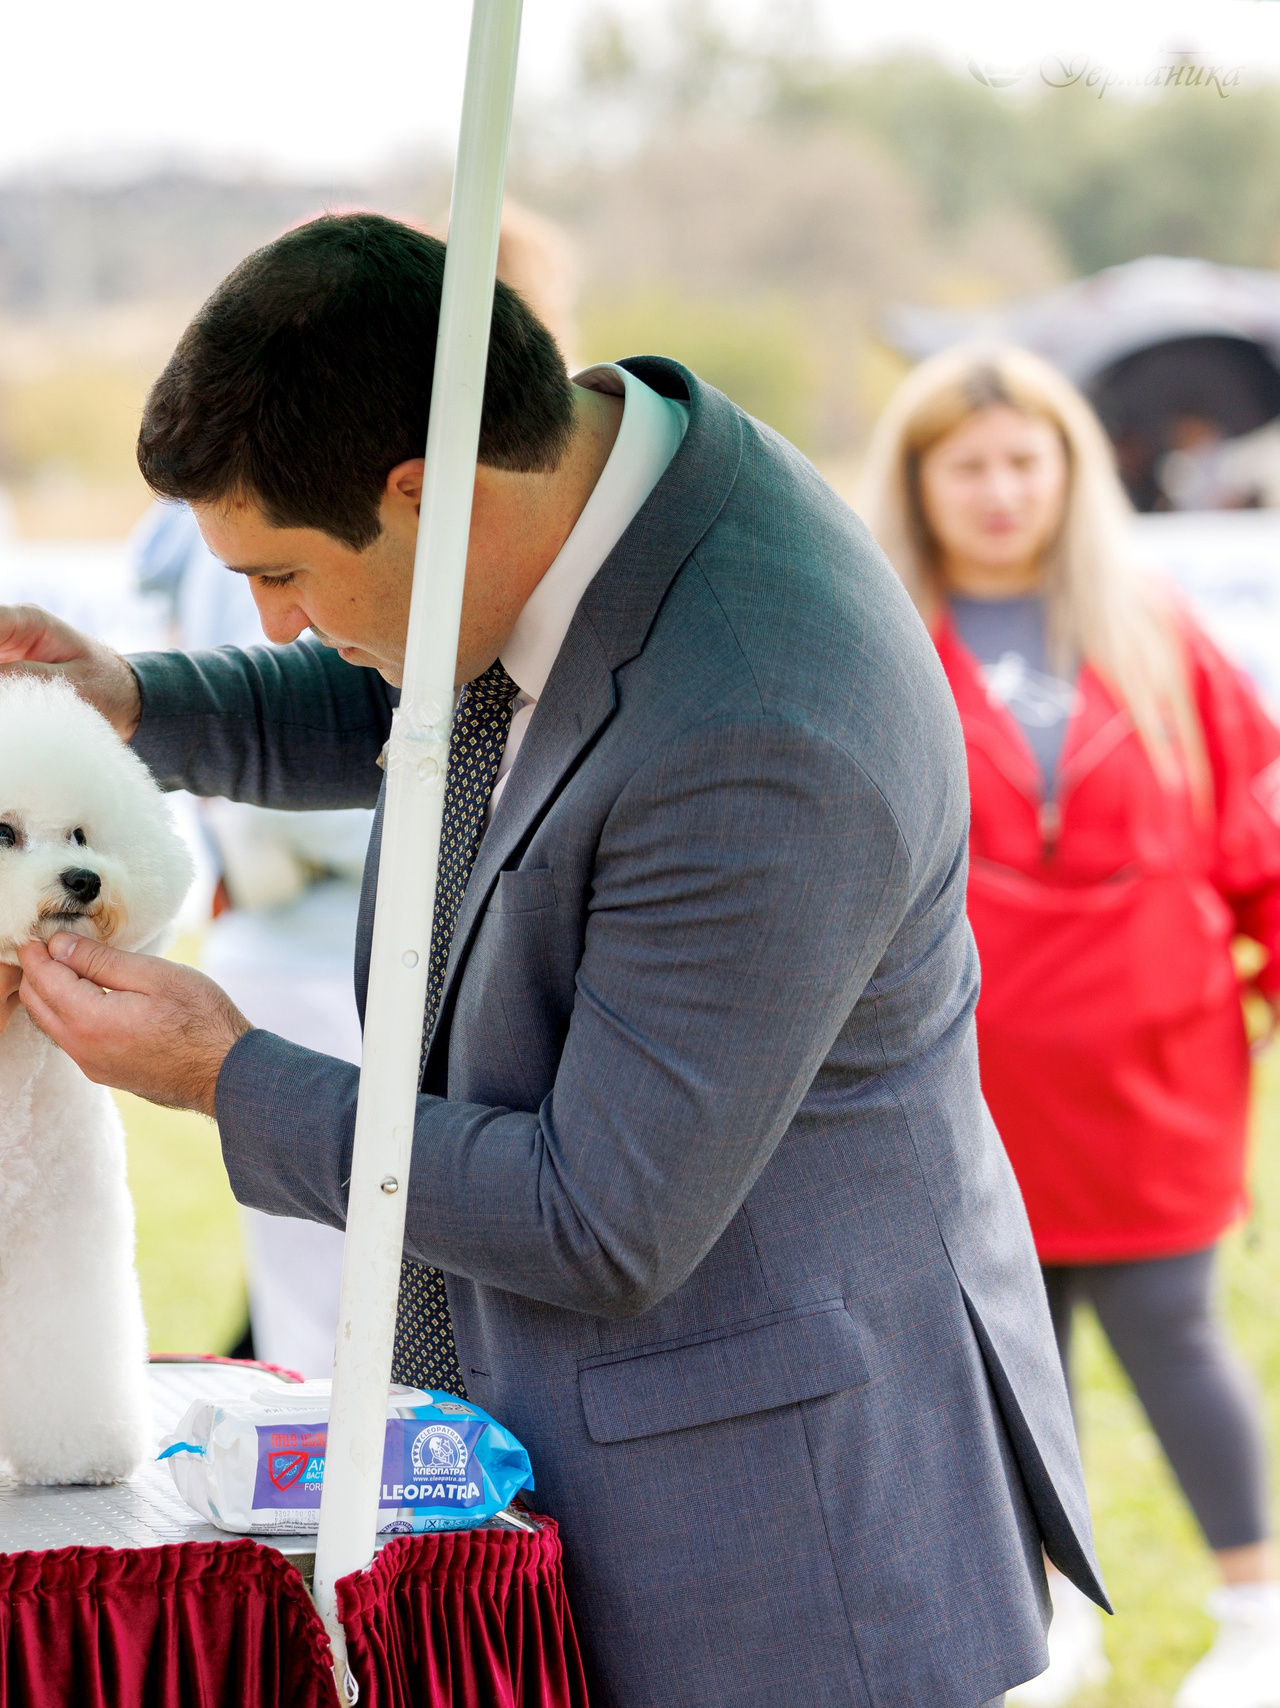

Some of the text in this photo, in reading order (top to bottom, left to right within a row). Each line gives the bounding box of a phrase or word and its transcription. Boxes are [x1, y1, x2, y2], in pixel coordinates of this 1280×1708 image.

[419, 1426, 459, 1440] CLEOPATRA
[413, 1467, 466, 1476] КЛЕОПАТРА
[379, 1482, 480, 1500] LEOPATRA
